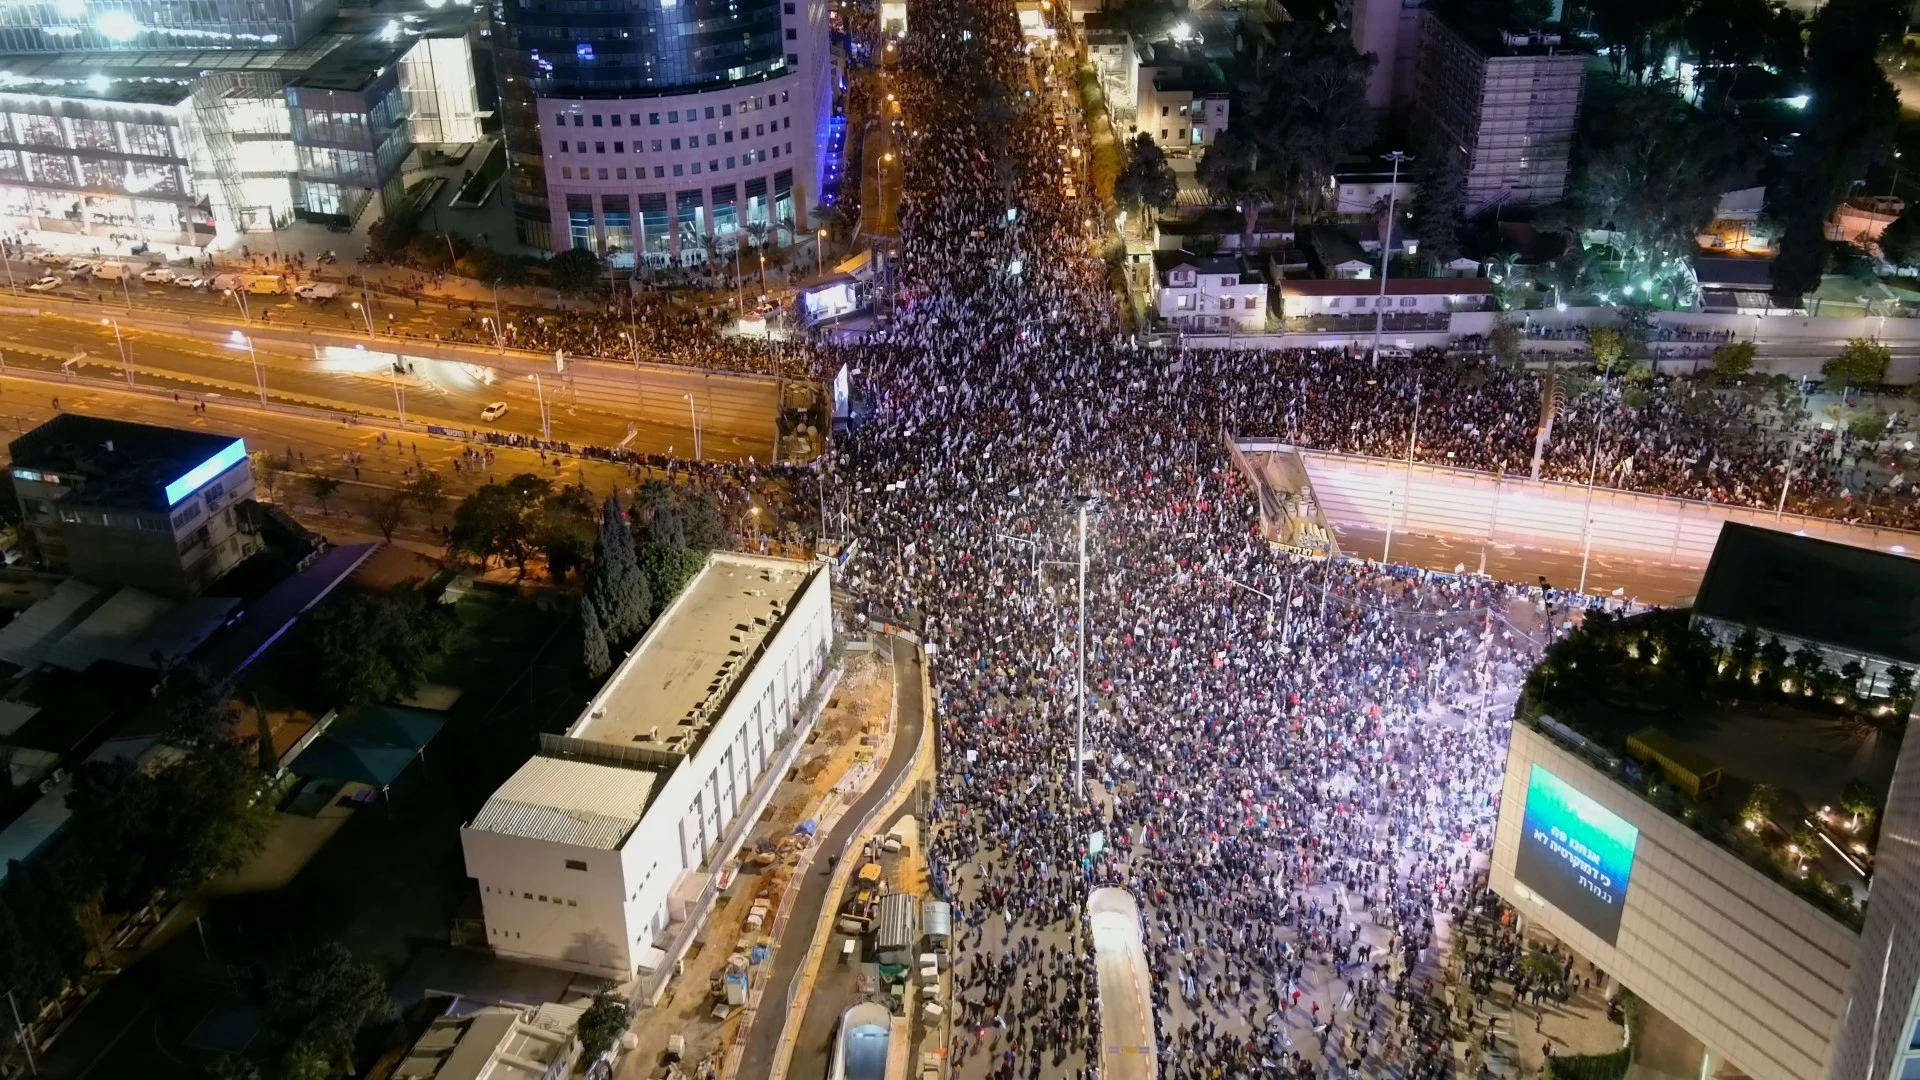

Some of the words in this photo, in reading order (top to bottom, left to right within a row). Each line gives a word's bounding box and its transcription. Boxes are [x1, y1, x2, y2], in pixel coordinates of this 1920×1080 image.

[1534, 829, 1549, 844] לא
[1551, 825, 1567, 842] פה
[1569, 838, 1600, 865] אנחנו
[1578, 875, 1612, 903] נגמרת
[1601, 874, 1611, 887] כי
